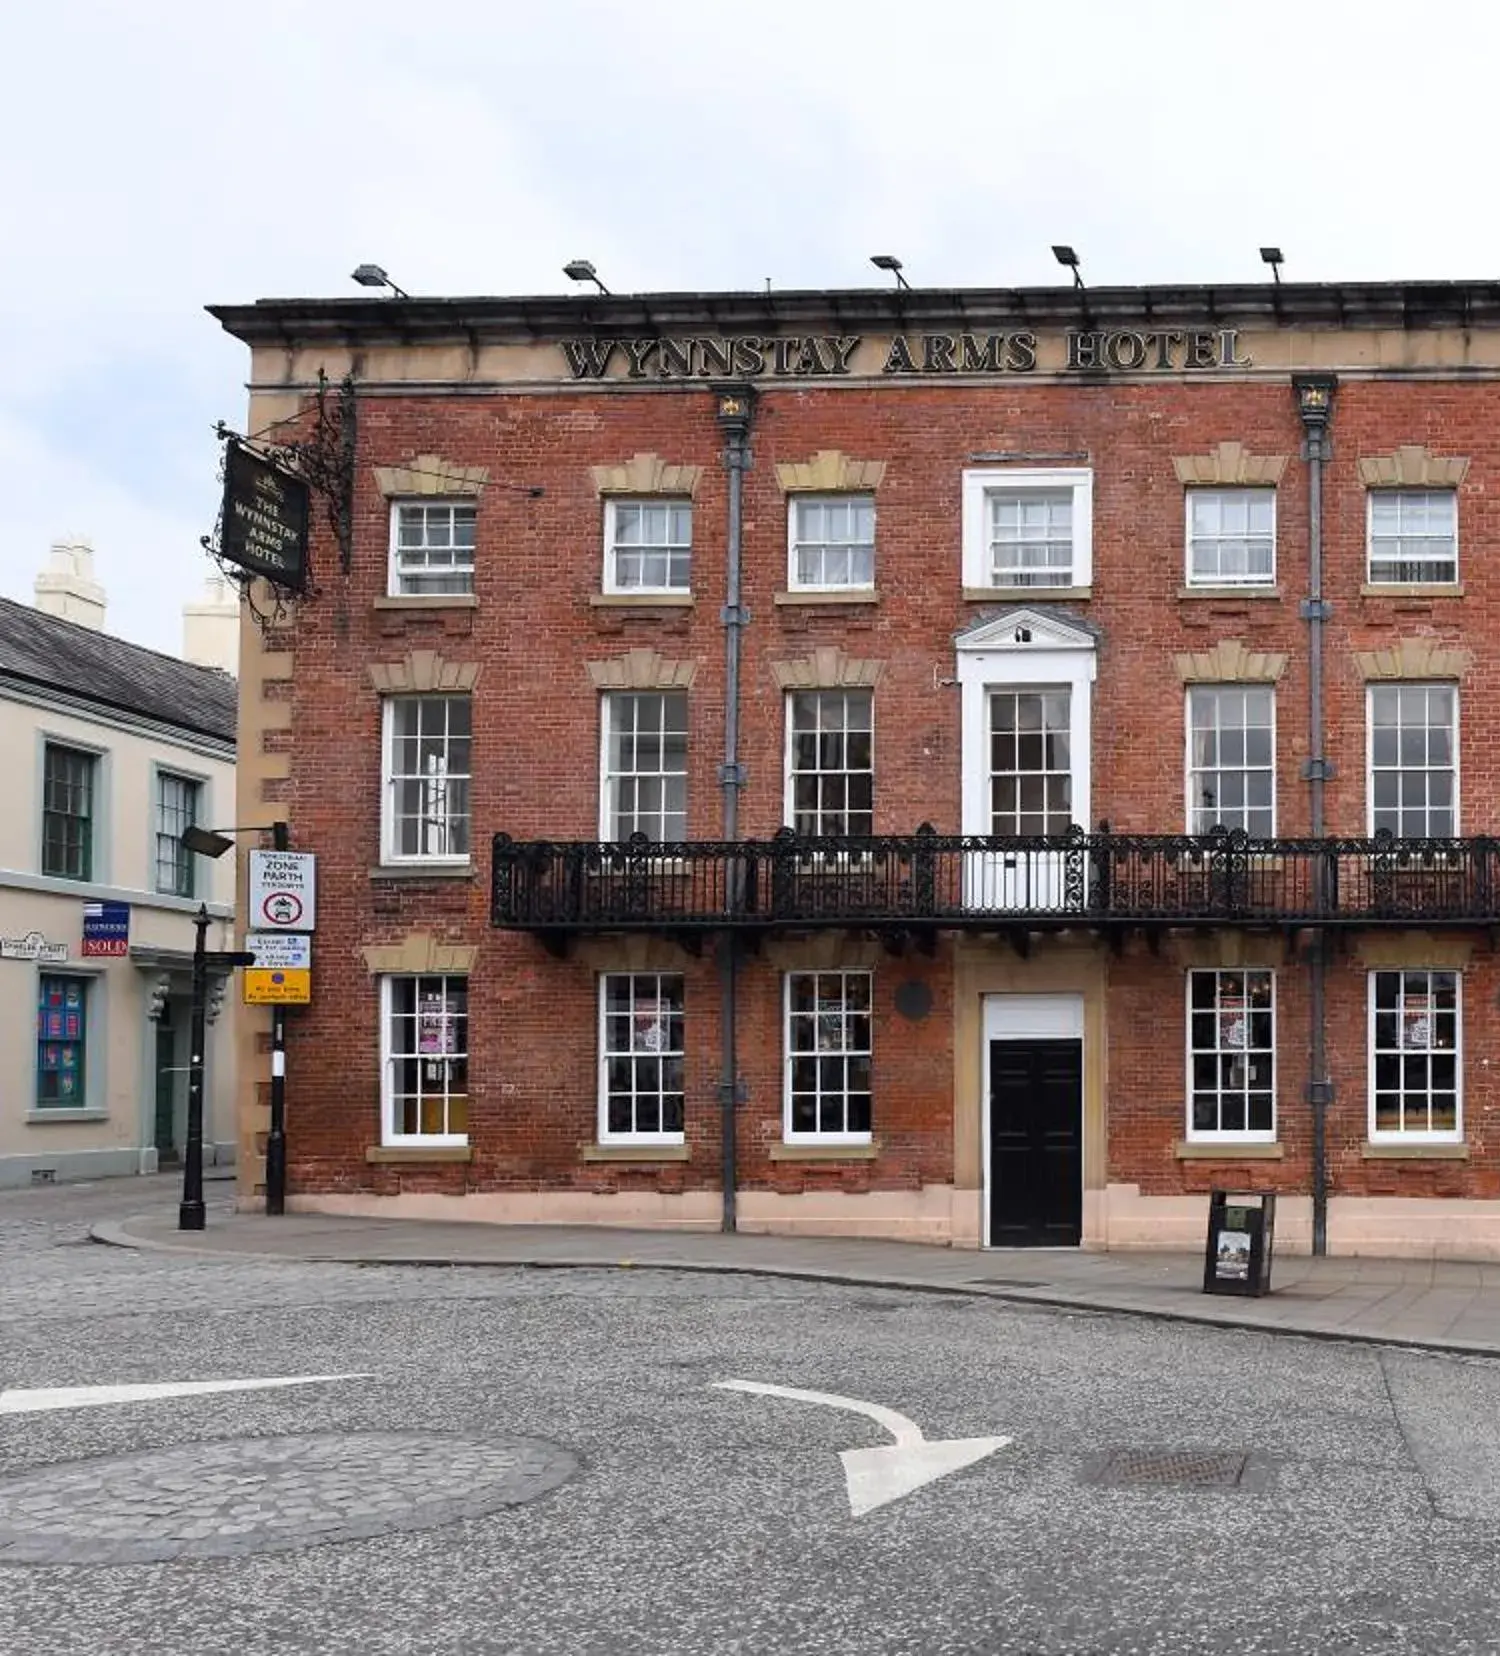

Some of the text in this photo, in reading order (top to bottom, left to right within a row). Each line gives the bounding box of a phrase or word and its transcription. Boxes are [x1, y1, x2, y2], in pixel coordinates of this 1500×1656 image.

[561, 328, 1252, 378] WYNNSTAY ARMS HOTEL
[256, 496, 278, 517] THE
[235, 500, 299, 541] WYNNSTAY
[249, 527, 283, 551] ARMS
[245, 540, 285, 569] HOTEL
[263, 871, 303, 881] PARTH
[265, 861, 299, 871] ZONE
[87, 940, 128, 952] SOLD
